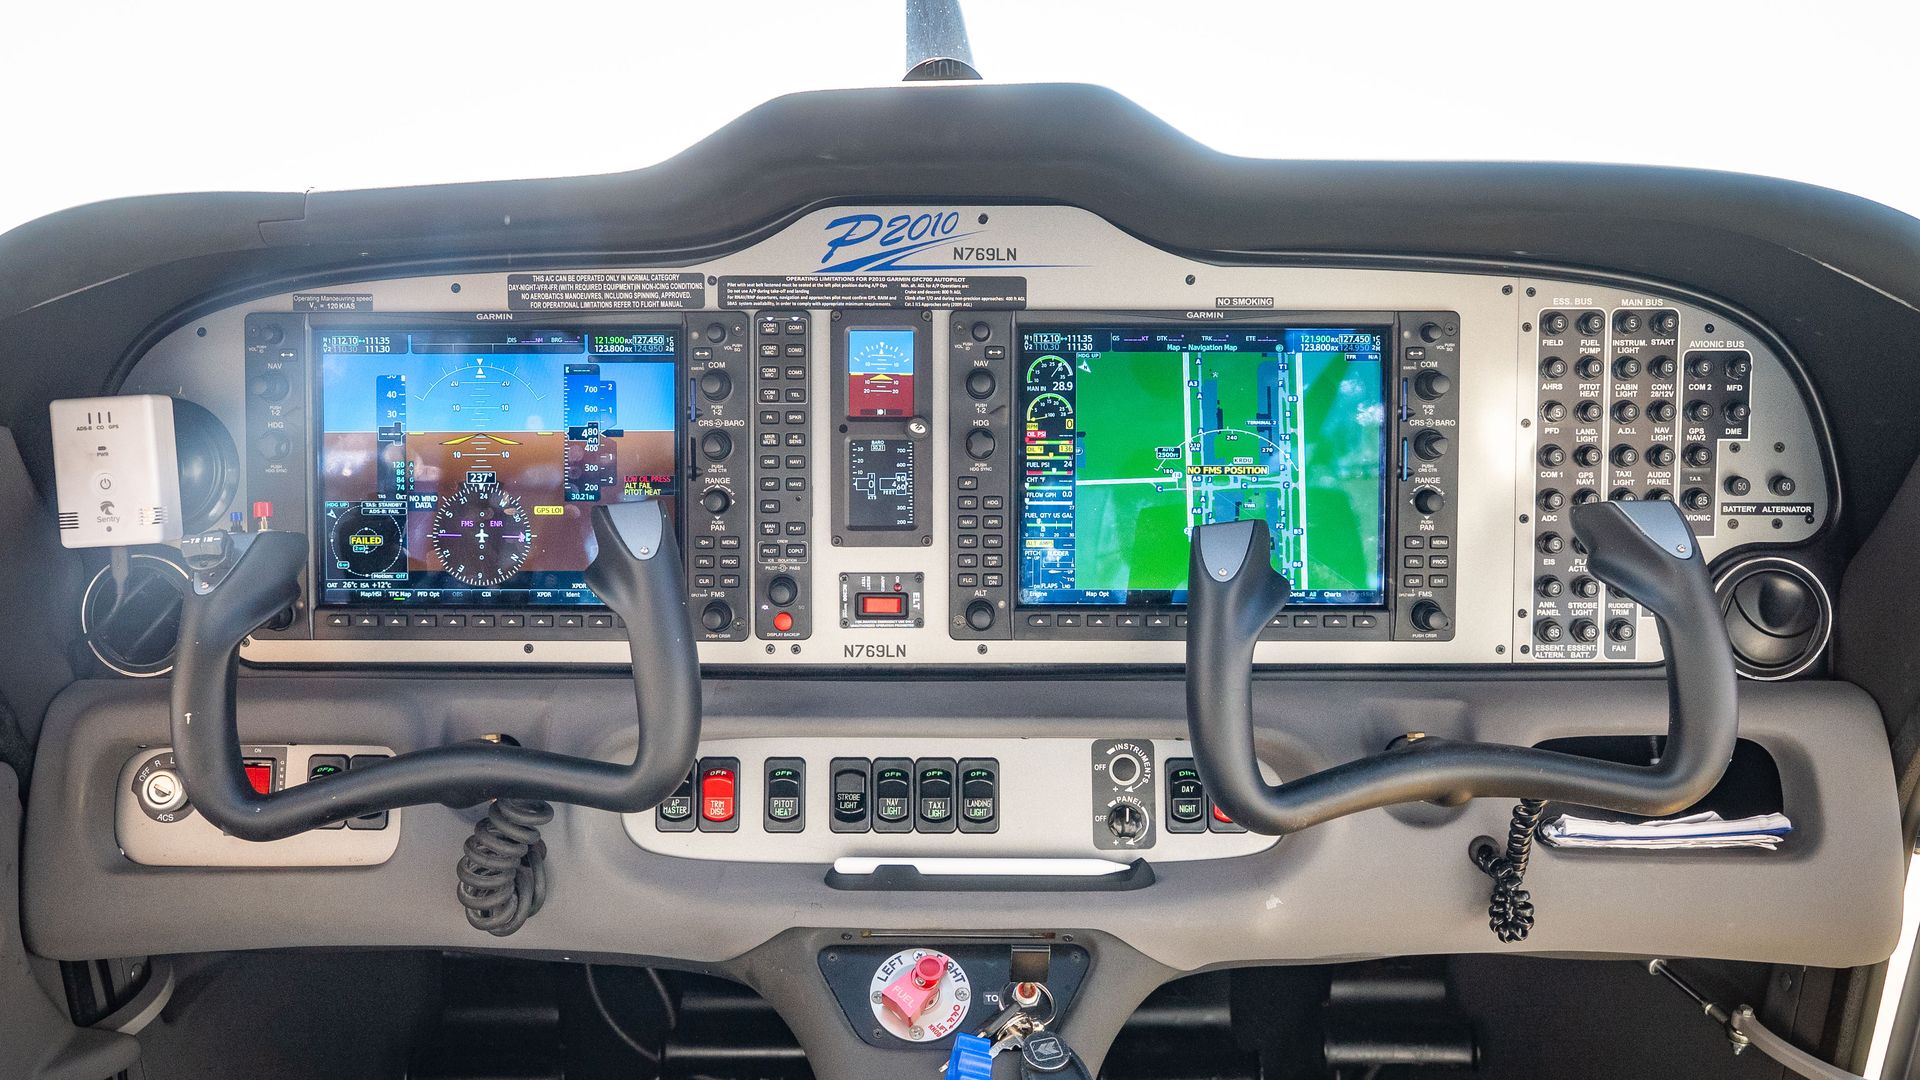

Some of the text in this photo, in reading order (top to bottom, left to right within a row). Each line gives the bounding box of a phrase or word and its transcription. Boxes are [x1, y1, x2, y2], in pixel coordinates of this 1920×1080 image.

[821, 212, 958, 263] P2010
[953, 248, 1017, 260] N769LN
[1188, 344, 1222, 352] Navigation
[1690, 340, 1723, 348] AVIONIC
[1053, 382, 1073, 391] 28.9
[97, 515, 120, 523] Sentry
[912, 592, 920, 609] ELT
[844, 645, 906, 658] N769LN
[1114, 743, 1151, 784] INSTRUMENTS
[138, 767, 151, 782] OFF
[711, 800, 725, 808] TRIM
[774, 800, 793, 808] PITOT
[887, 798, 898, 806] NAV
[1116, 796, 1143, 807] PANEL
[970, 808, 987, 816] LIGHT
[1179, 804, 1195, 812] NIGHT
[157, 814, 174, 822] ACS
[877, 956, 903, 982] LEFT
[892, 986, 914, 1009] FUEL
[947, 1005, 960, 1023] OFF
[929, 1024, 941, 1037] KNOB
[937, 1023, 947, 1033] LIFT
